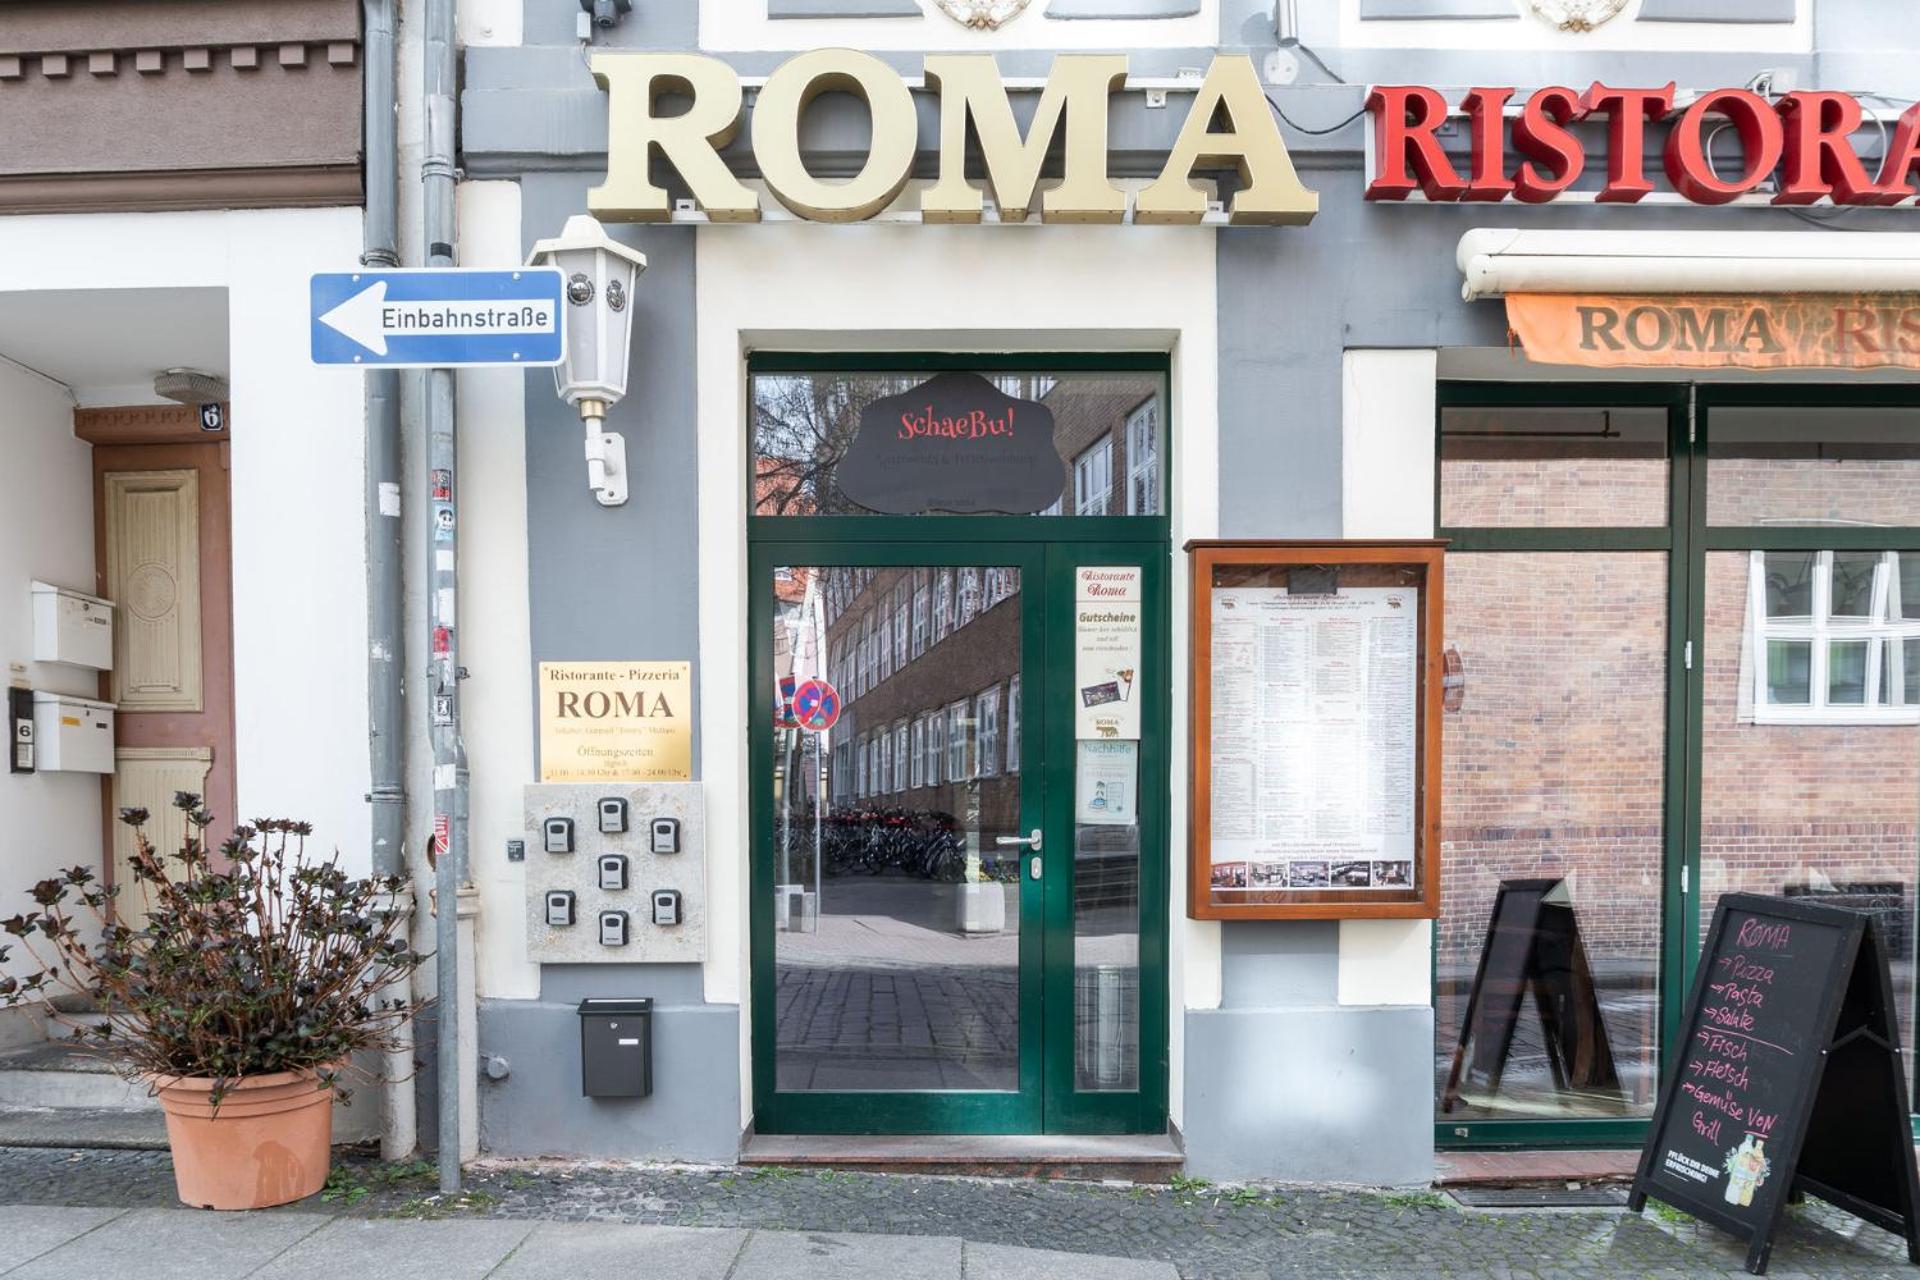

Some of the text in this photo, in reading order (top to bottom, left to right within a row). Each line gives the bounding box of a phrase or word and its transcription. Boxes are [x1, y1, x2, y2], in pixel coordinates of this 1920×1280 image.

[587, 47, 1319, 224] ROMA
[383, 306, 548, 328] Einbahnstraße
[1577, 305, 1783, 354] ROMA
[204, 405, 218, 427] 6
[898, 405, 1015, 440] SchaeBu!
[1081, 570, 1135, 581] Ristorante
[1087, 583, 1127, 596] Roma
[1079, 611, 1136, 623] Gutscheine
[550, 669, 616, 681] Ristorante
[628, 669, 680, 681] Pizzeria
[557, 691, 674, 718] ROMA
[19, 725, 31, 737] 6
[1736, 918, 1790, 950] ROMA
[1731, 954, 1774, 985] Pizza
[1724, 982, 1763, 1008] Pasta
[1703, 1060, 1748, 1091] Fleisch
[1694, 1085, 1743, 1121] Gemüse
[1692, 1111, 1721, 1146] Grill
